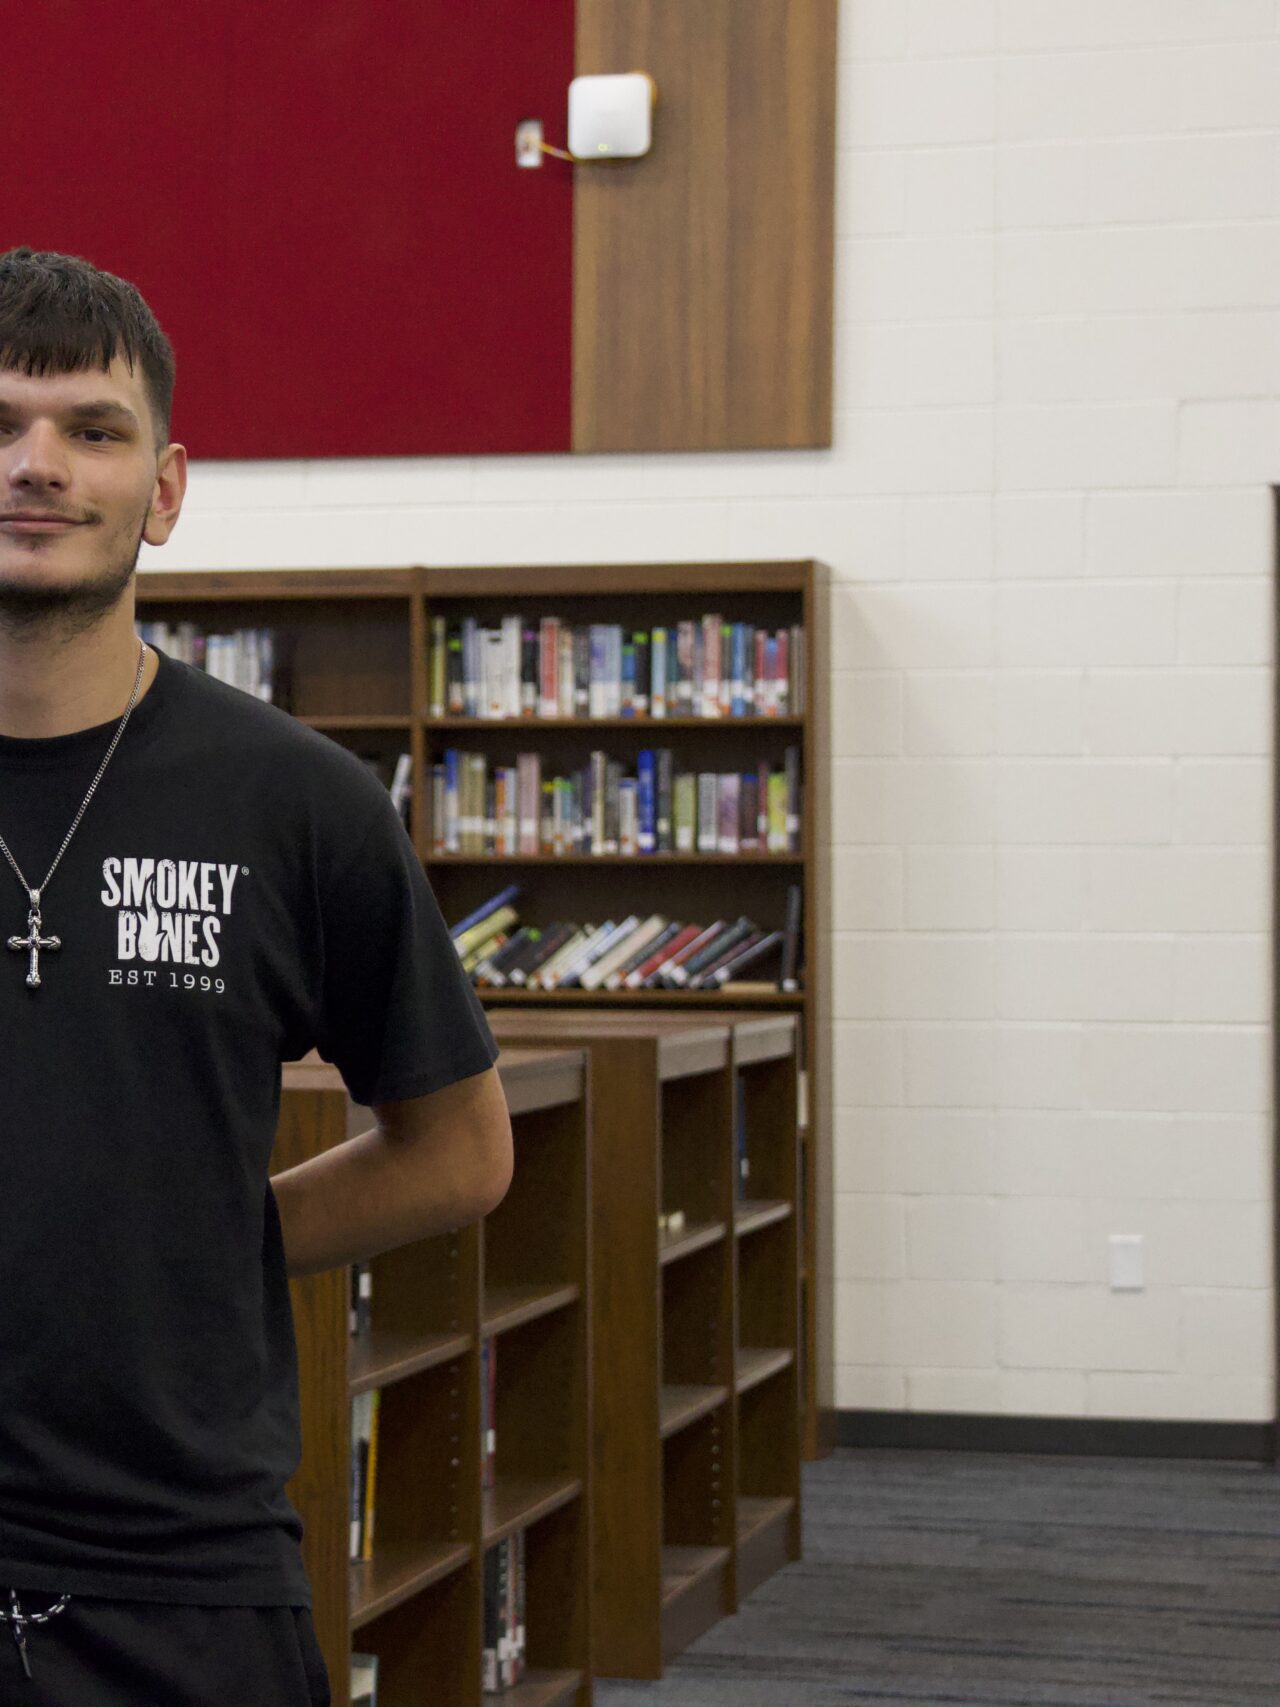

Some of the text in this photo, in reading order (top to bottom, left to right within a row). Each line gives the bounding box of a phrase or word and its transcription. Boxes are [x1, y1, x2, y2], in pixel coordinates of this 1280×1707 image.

[117, 909, 221, 968] BONES
[108, 969, 226, 994] EST 1999
